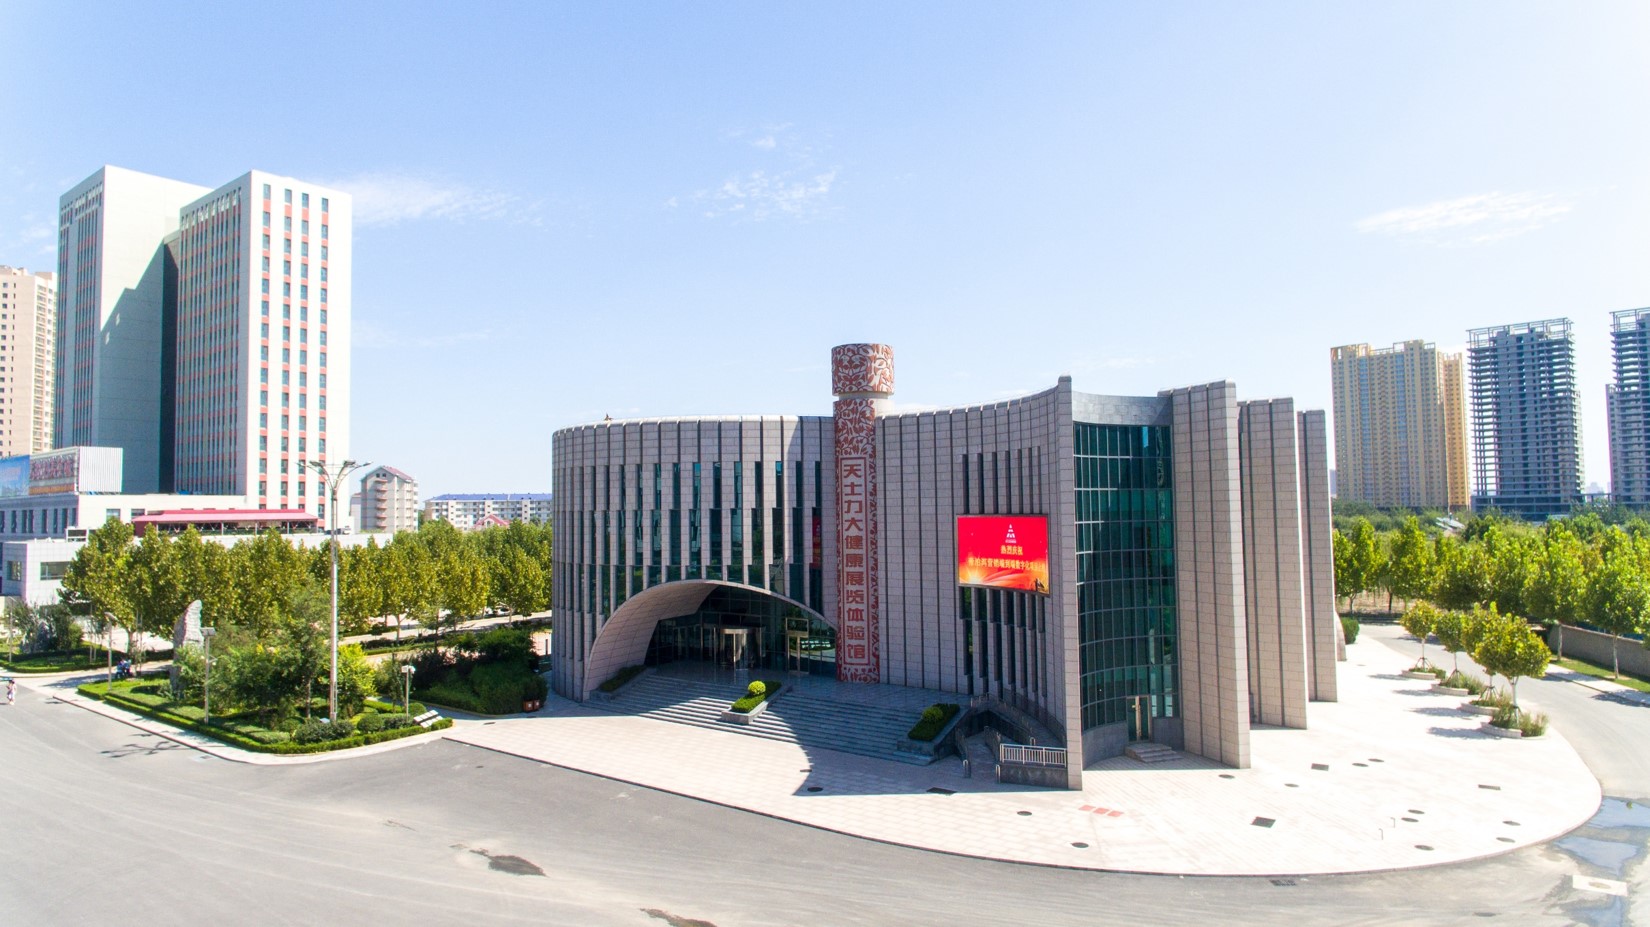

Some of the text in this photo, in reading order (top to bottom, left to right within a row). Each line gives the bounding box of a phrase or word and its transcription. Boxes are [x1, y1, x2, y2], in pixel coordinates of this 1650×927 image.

[843, 464, 865, 659] 天士力大健康展览体验馆
[1000, 545, 1023, 555] 热烈庆祝
